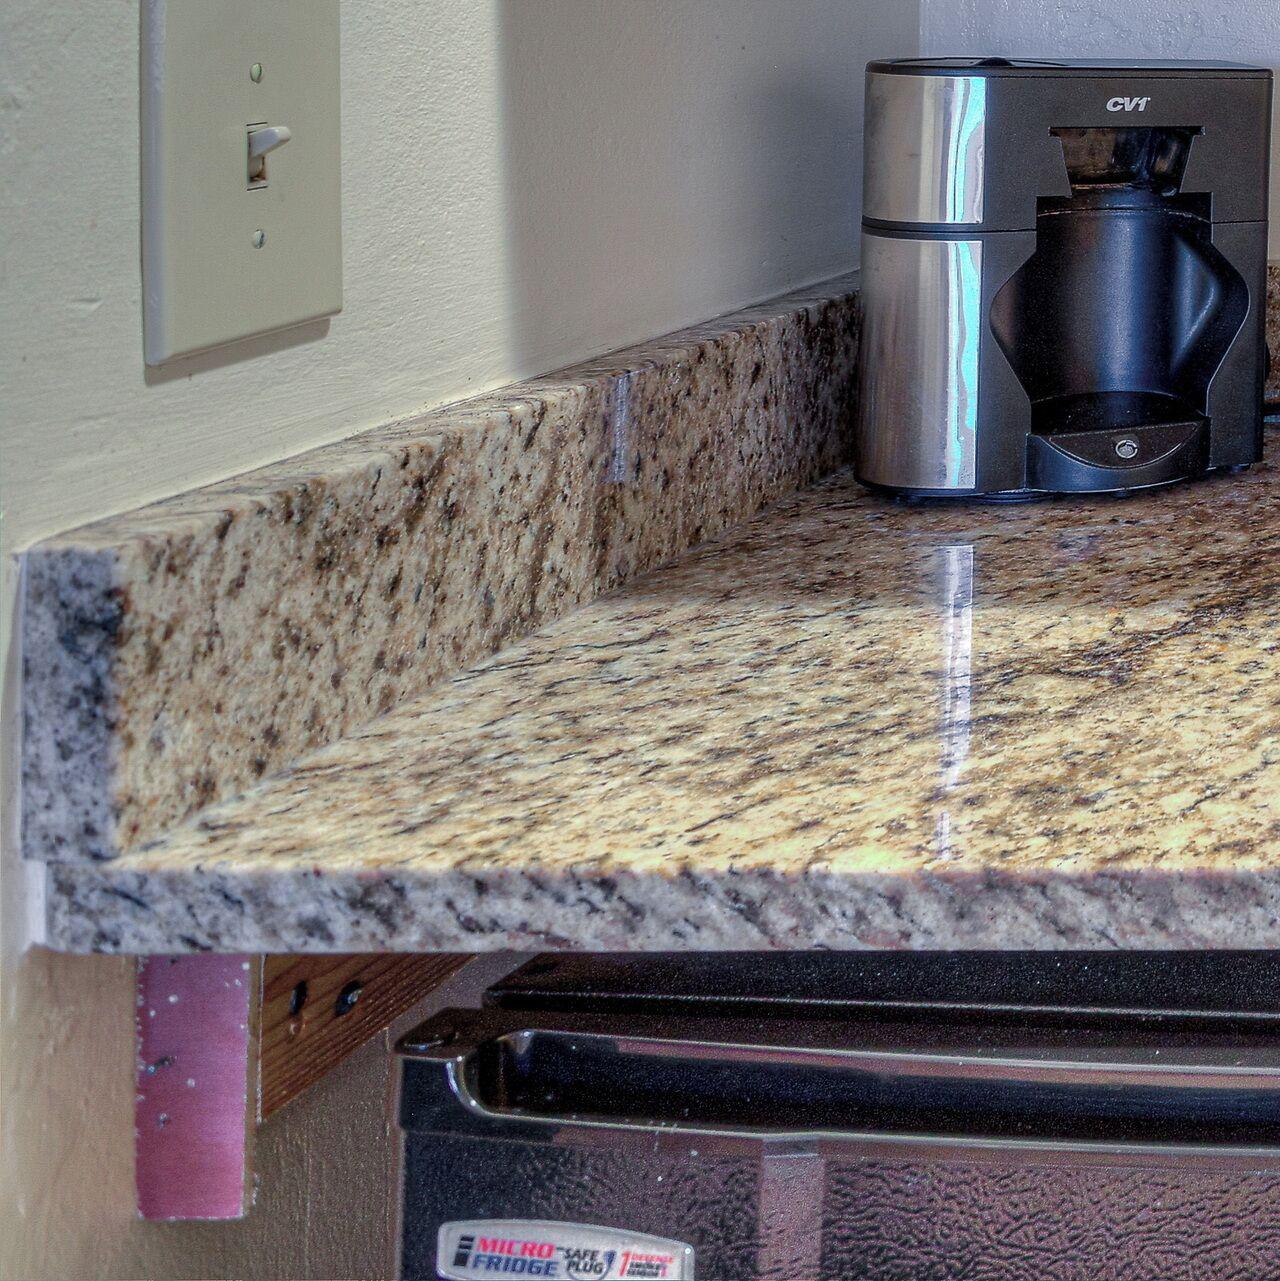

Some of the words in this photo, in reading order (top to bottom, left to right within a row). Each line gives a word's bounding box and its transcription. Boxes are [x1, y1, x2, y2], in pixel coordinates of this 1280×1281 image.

[1105, 96, 1148, 112] CV1
[478, 1237, 556, 1259] MICRO
[564, 1248, 599, 1261] SAFE
[473, 1254, 560, 1276] FRIDGE
[566, 1260, 603, 1274] PLUG
